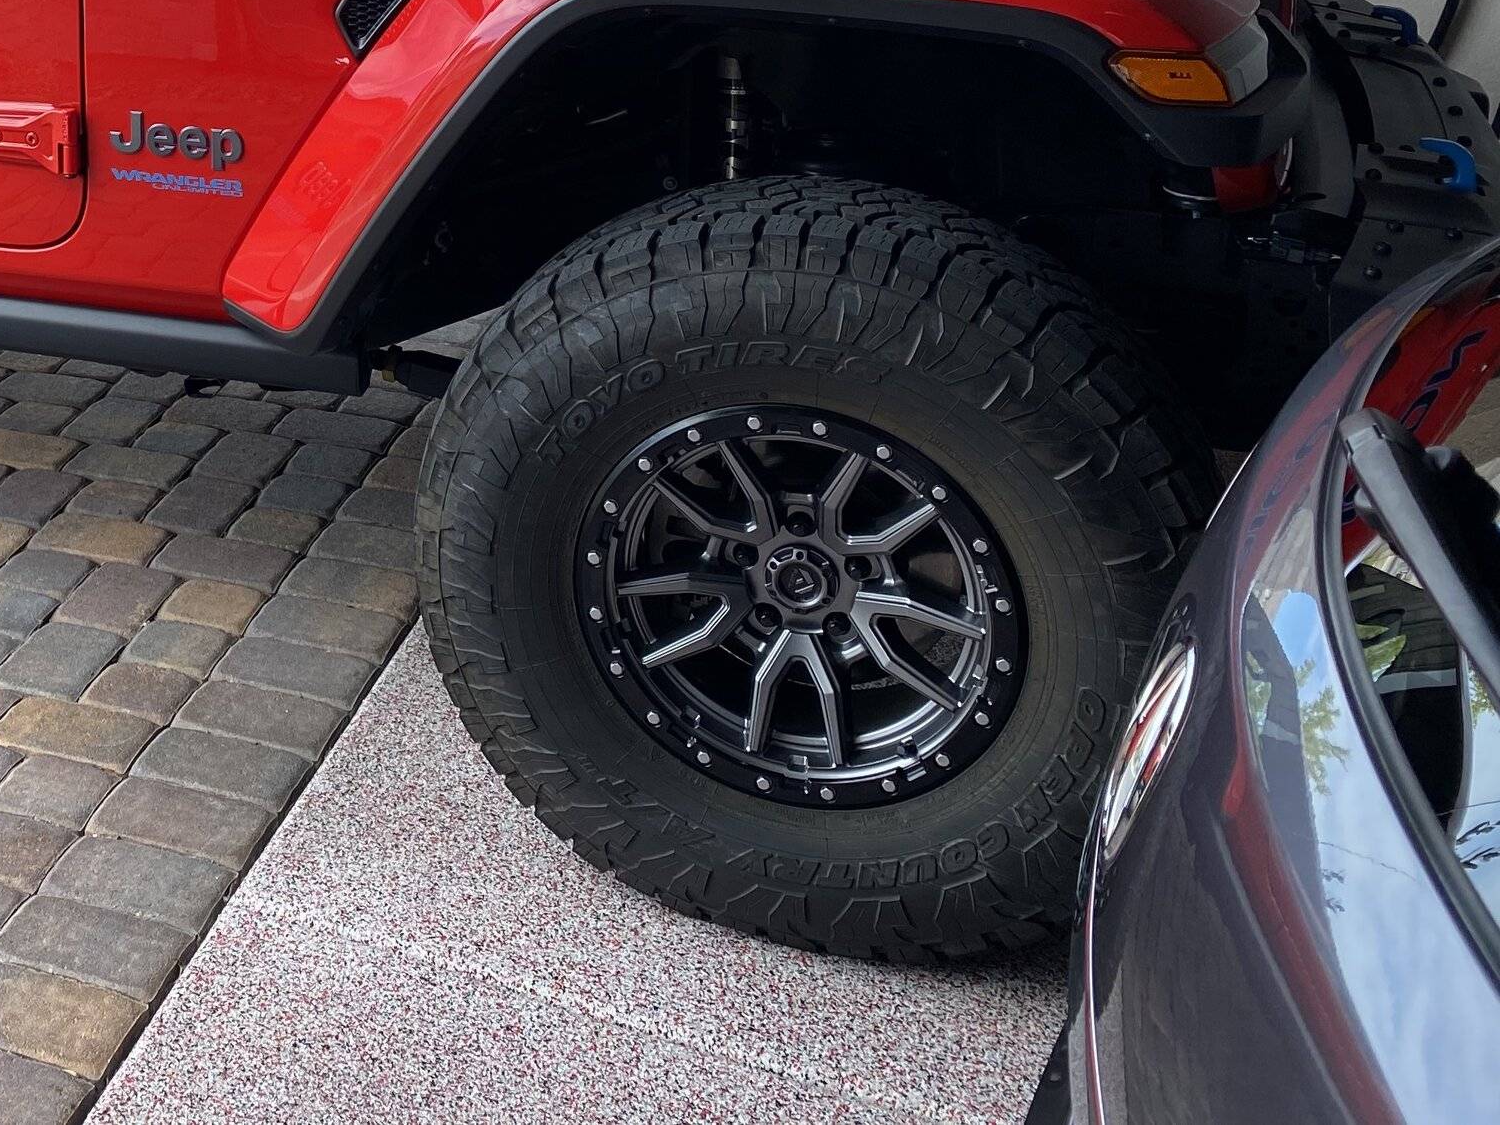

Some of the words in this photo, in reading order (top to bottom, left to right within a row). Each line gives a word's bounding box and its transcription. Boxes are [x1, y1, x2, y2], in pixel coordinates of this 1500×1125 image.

[109, 110, 245, 172] Jeep
[110, 167, 243, 191] WRANGLER
[152, 183, 244, 198] UNLIMITED
[534, 357, 668, 467] TOYO
